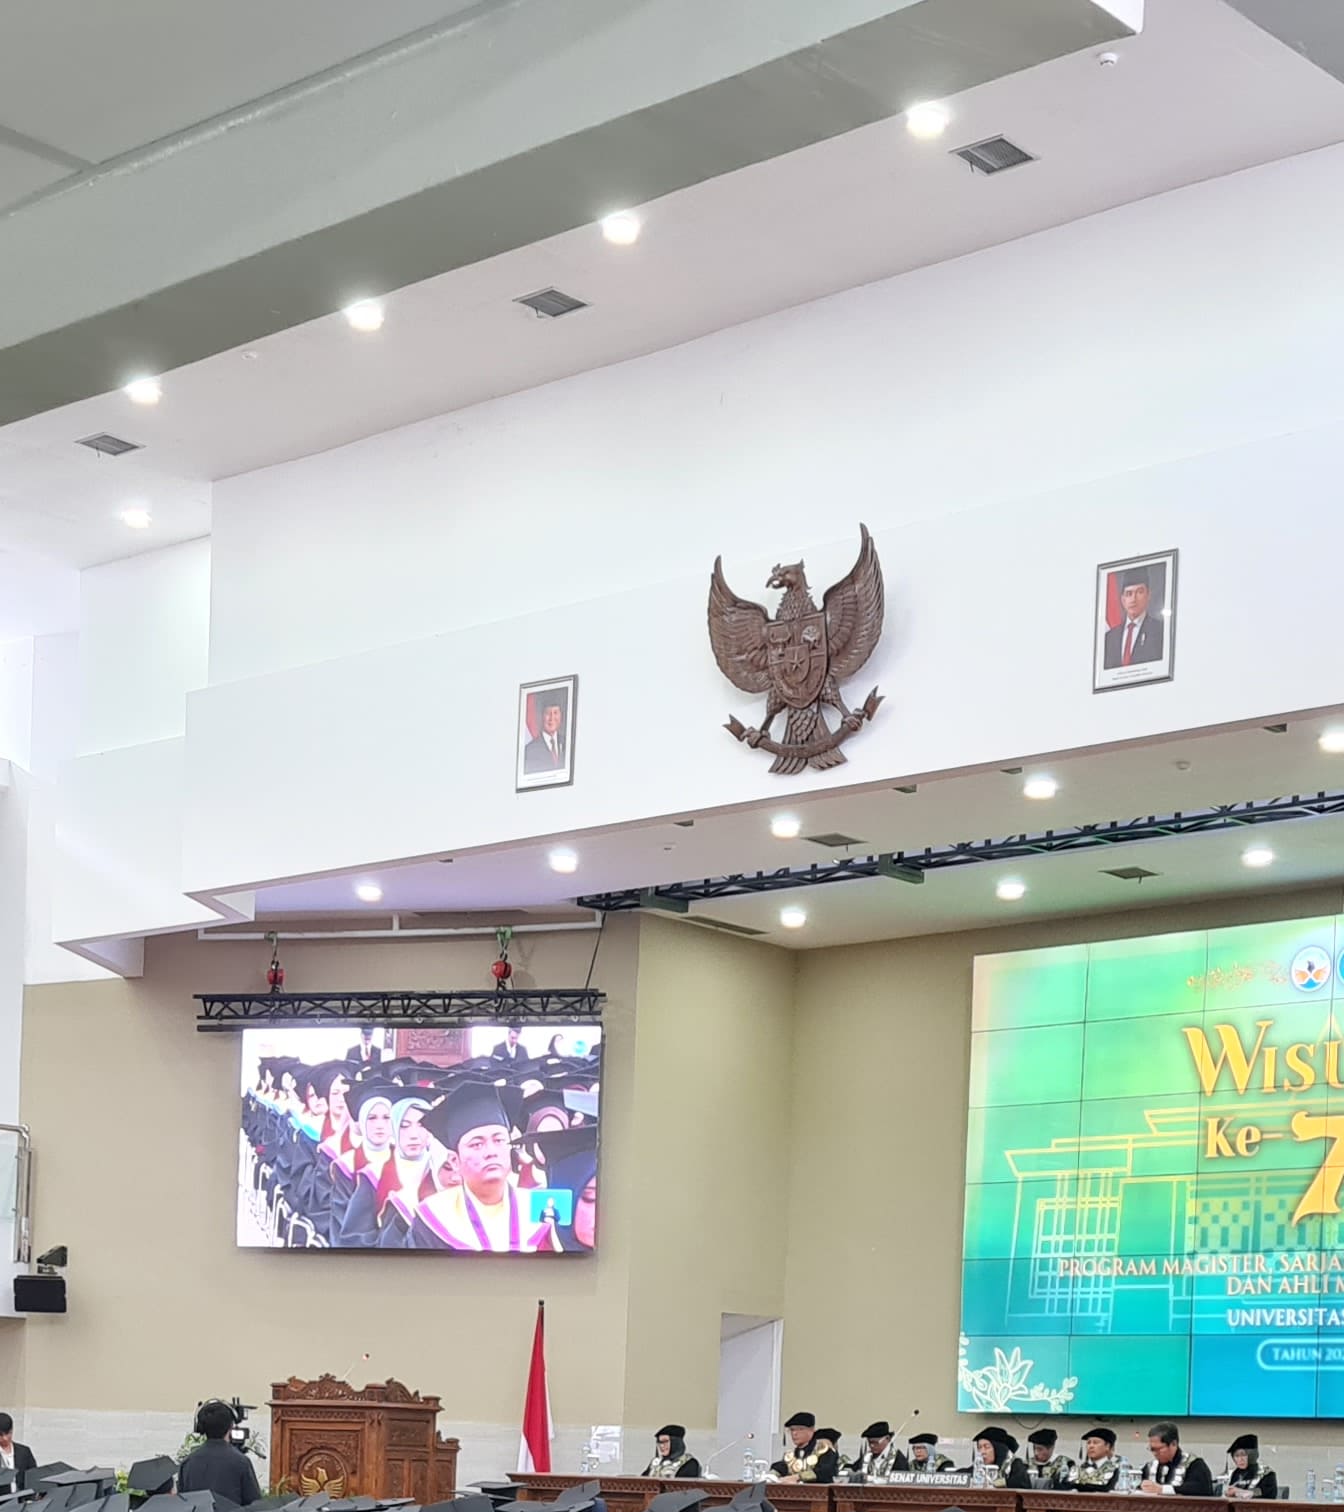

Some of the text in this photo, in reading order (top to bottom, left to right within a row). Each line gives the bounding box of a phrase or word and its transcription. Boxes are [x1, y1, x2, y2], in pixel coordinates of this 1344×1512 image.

[1058, 1258, 1156, 1277] PROGRAM
[1162, 1254, 1273, 1275] MAGISTER,
[1227, 1275, 1272, 1296] DAN
[1278, 1273, 1329, 1295] AHLI
[1272, 1347, 1321, 1361] TAHUN
[889, 1472, 968, 1486] SENAT UNIVERSITAS
